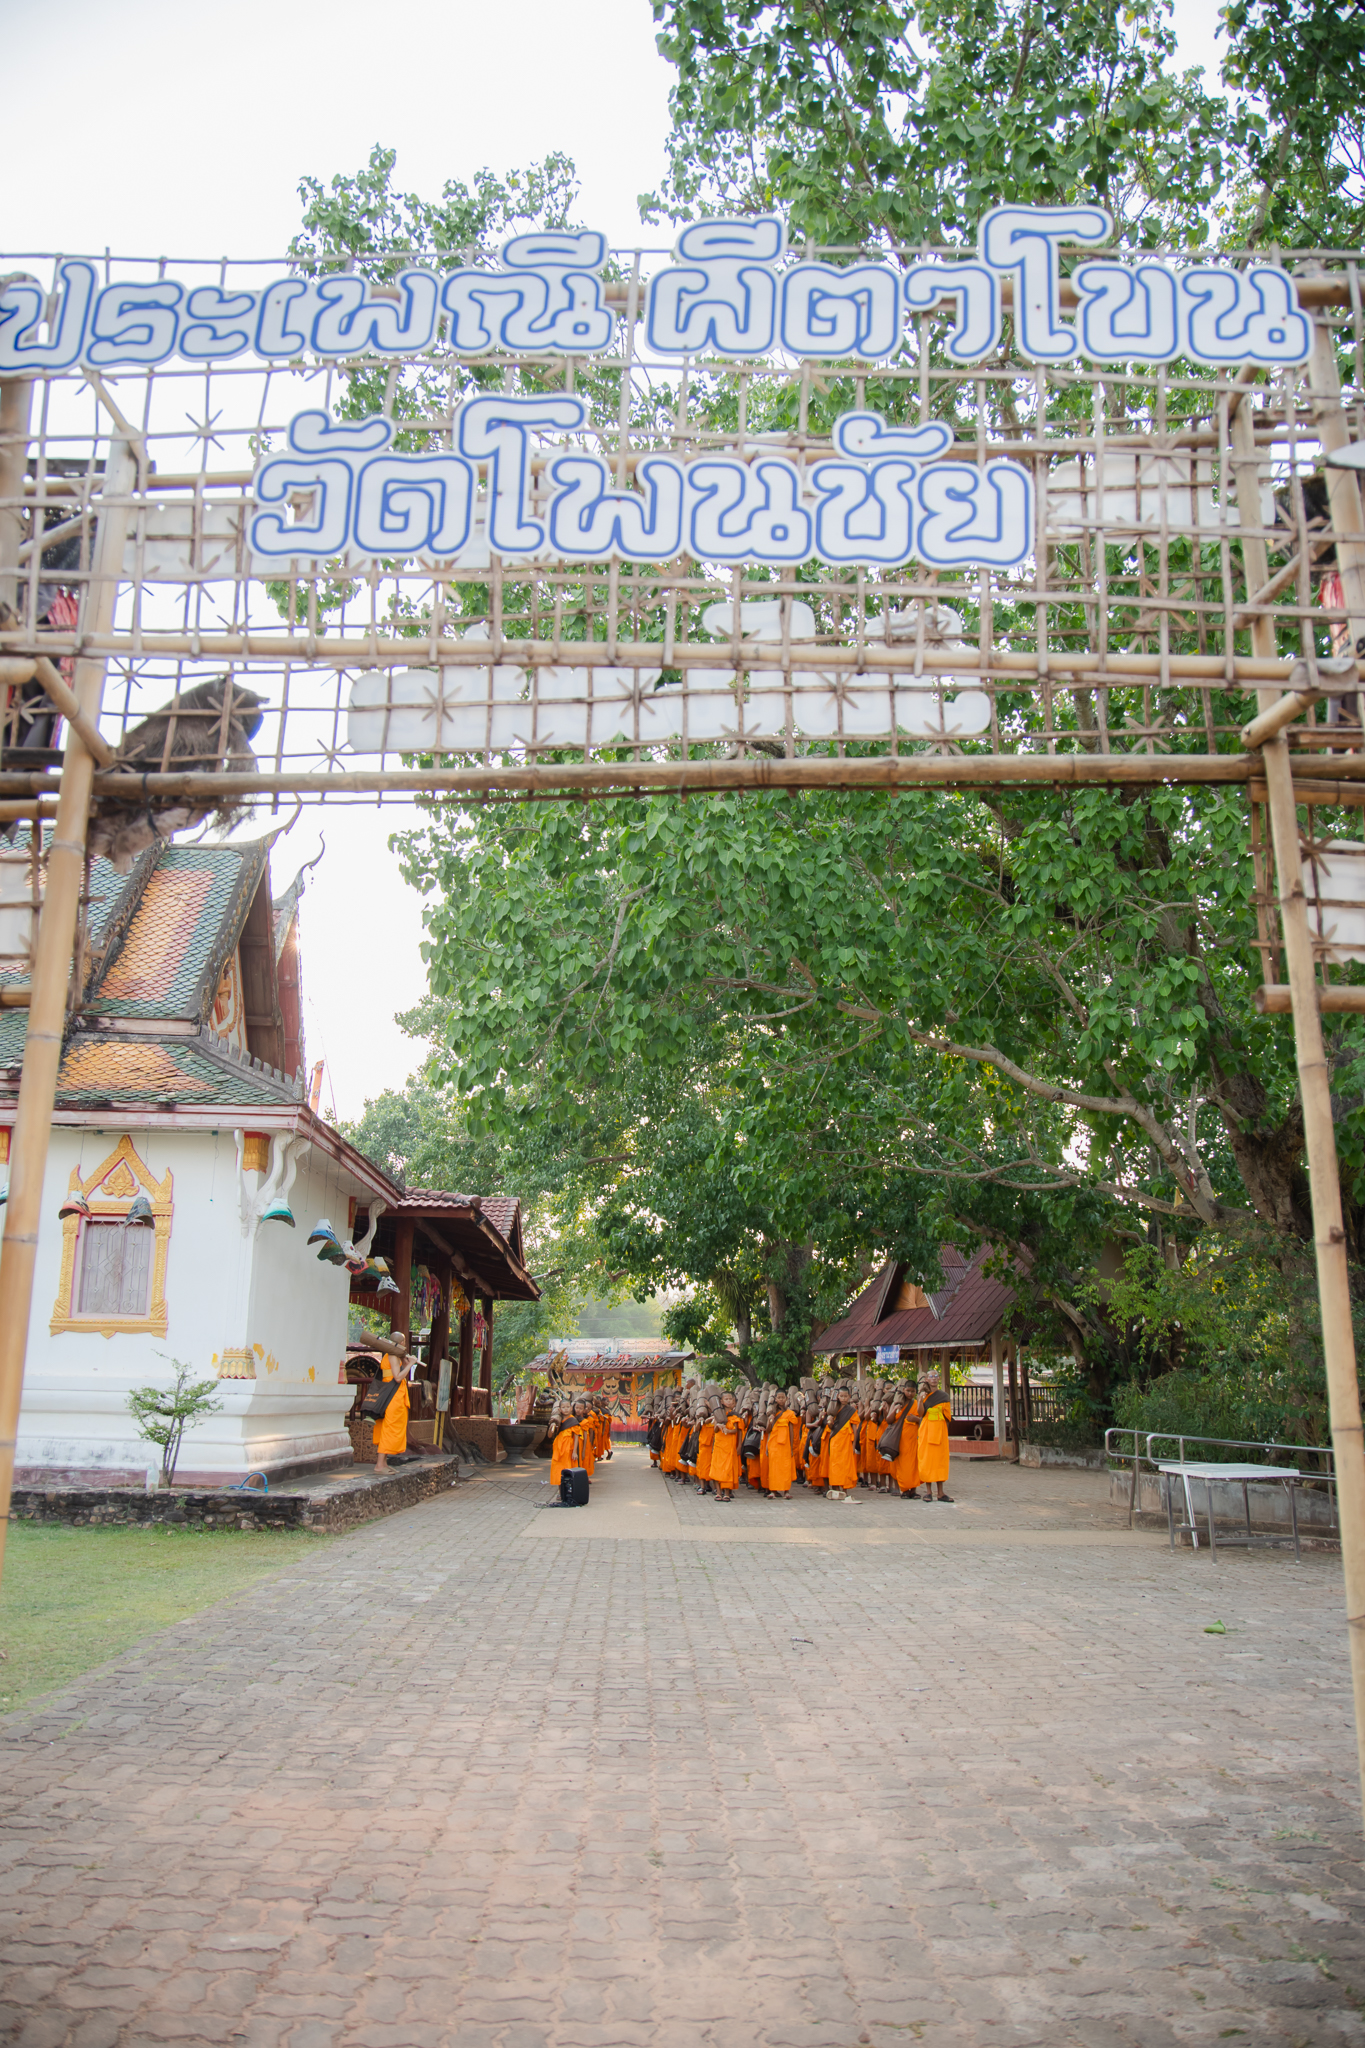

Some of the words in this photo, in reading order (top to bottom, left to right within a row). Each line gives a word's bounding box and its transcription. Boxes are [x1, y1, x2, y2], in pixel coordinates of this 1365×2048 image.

[0, 232, 611, 371] ประเพณี
[646, 208, 1314, 366] ผีตาโขน
[250, 397, 1034, 566] วัดโพนชัย
